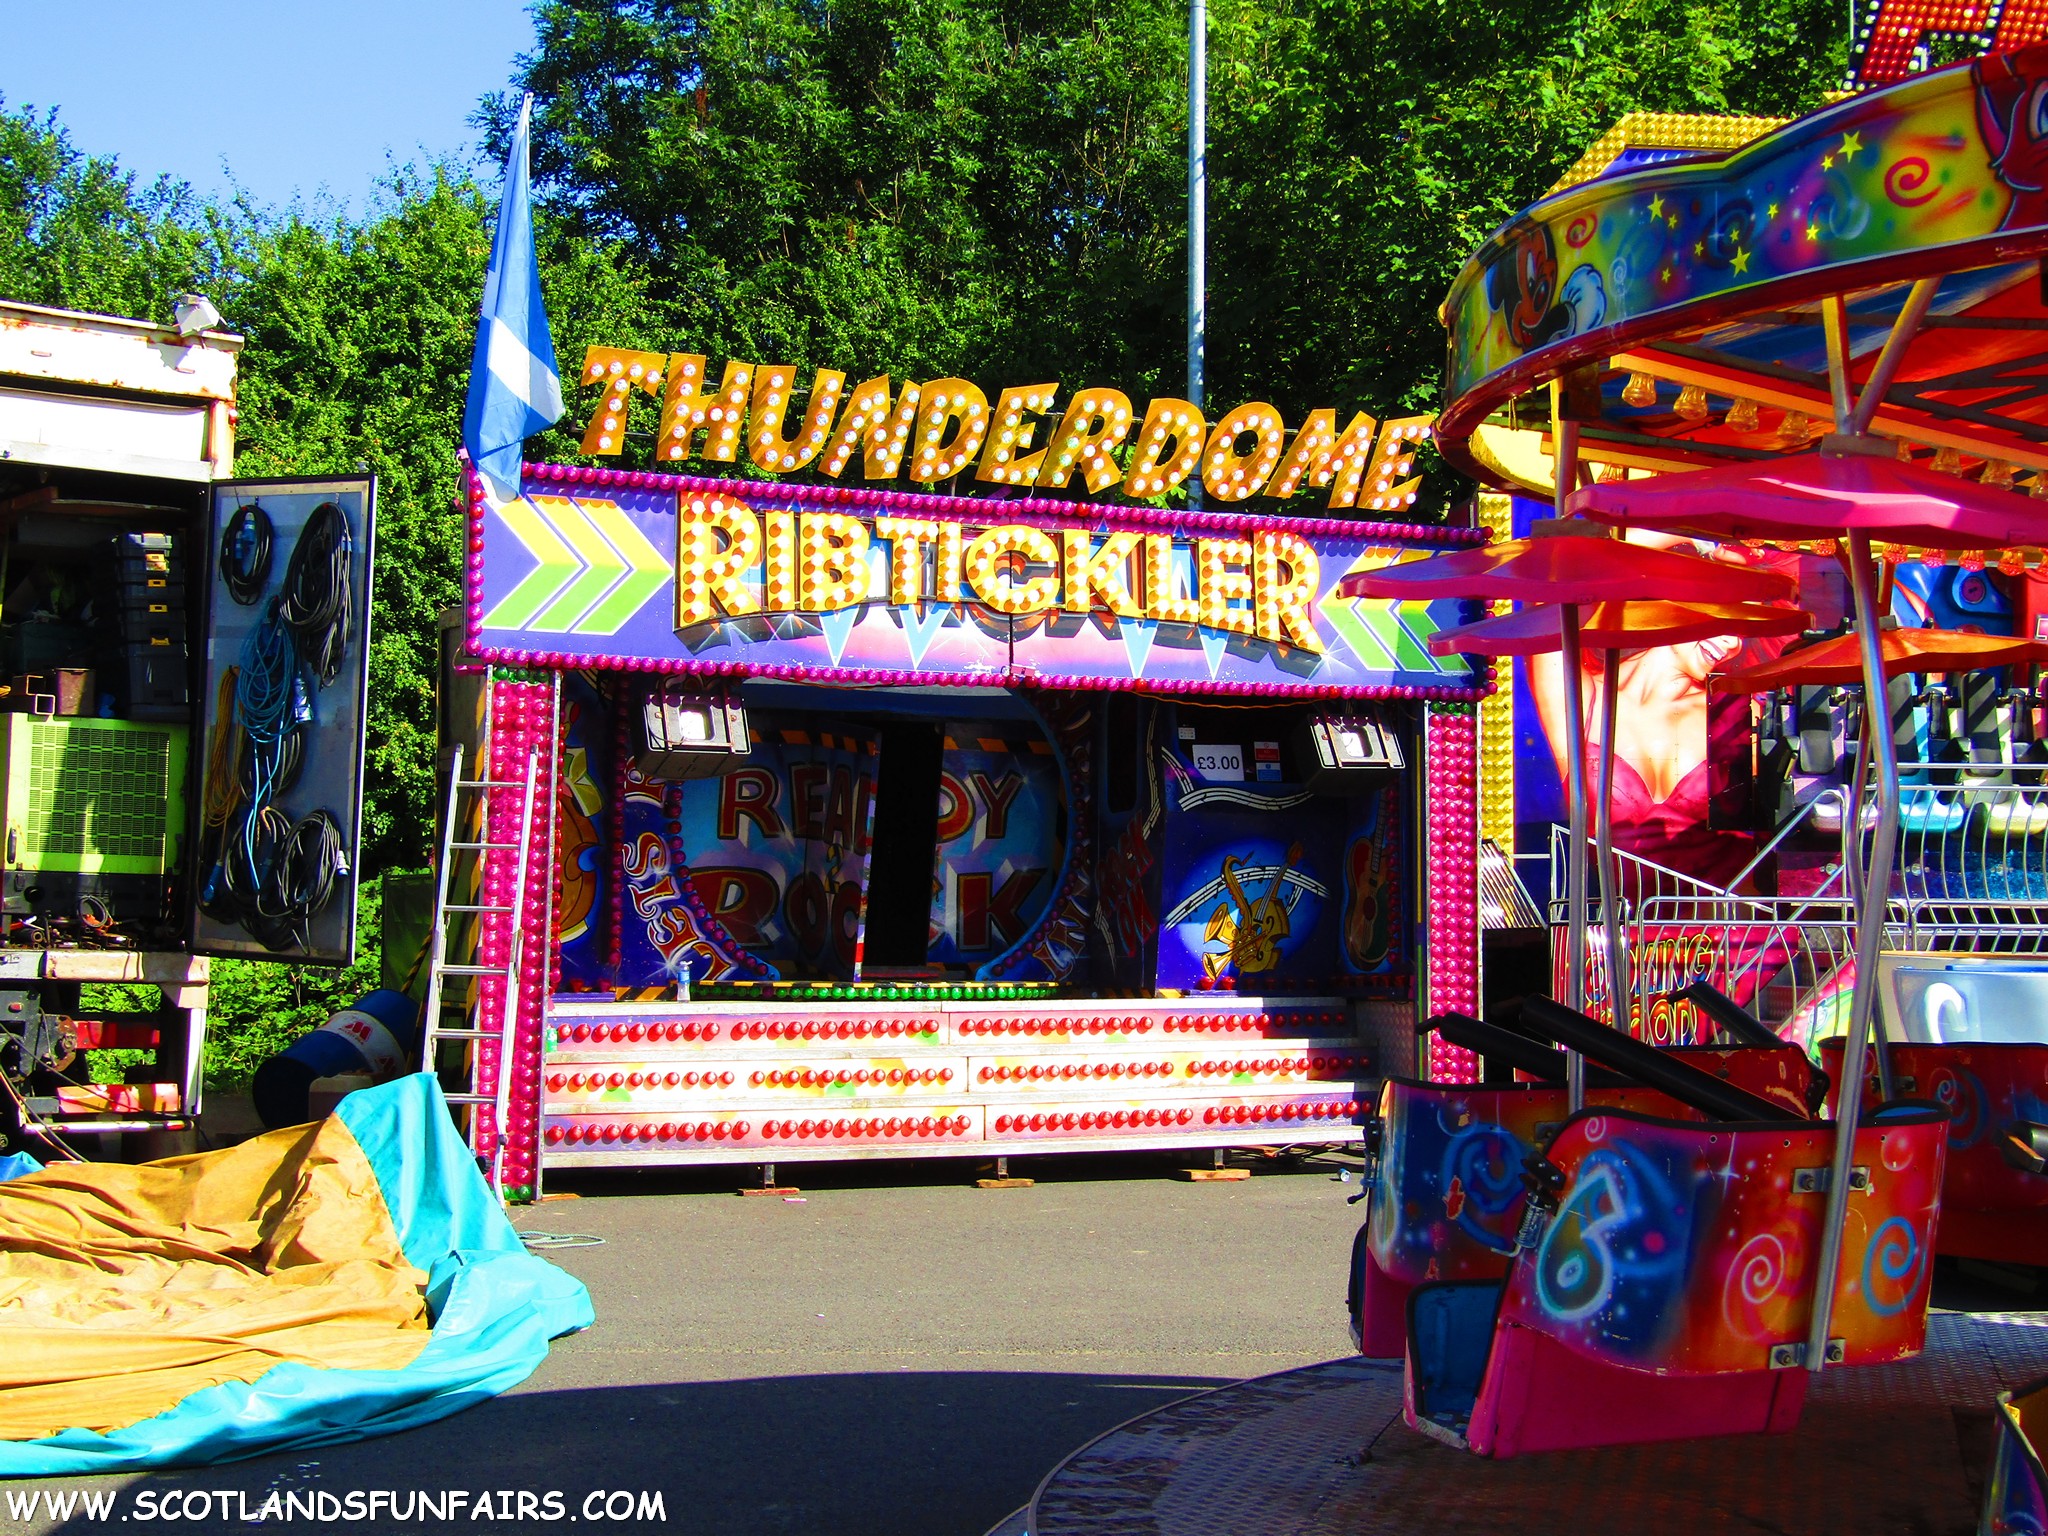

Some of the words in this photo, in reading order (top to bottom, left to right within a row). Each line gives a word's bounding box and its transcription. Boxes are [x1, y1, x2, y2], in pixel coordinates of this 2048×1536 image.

[581, 344, 1434, 512] THUNDERDOME
[674, 491, 1324, 656] RIBTICKLER
[1197, 756, 1240, 770] £3.00
